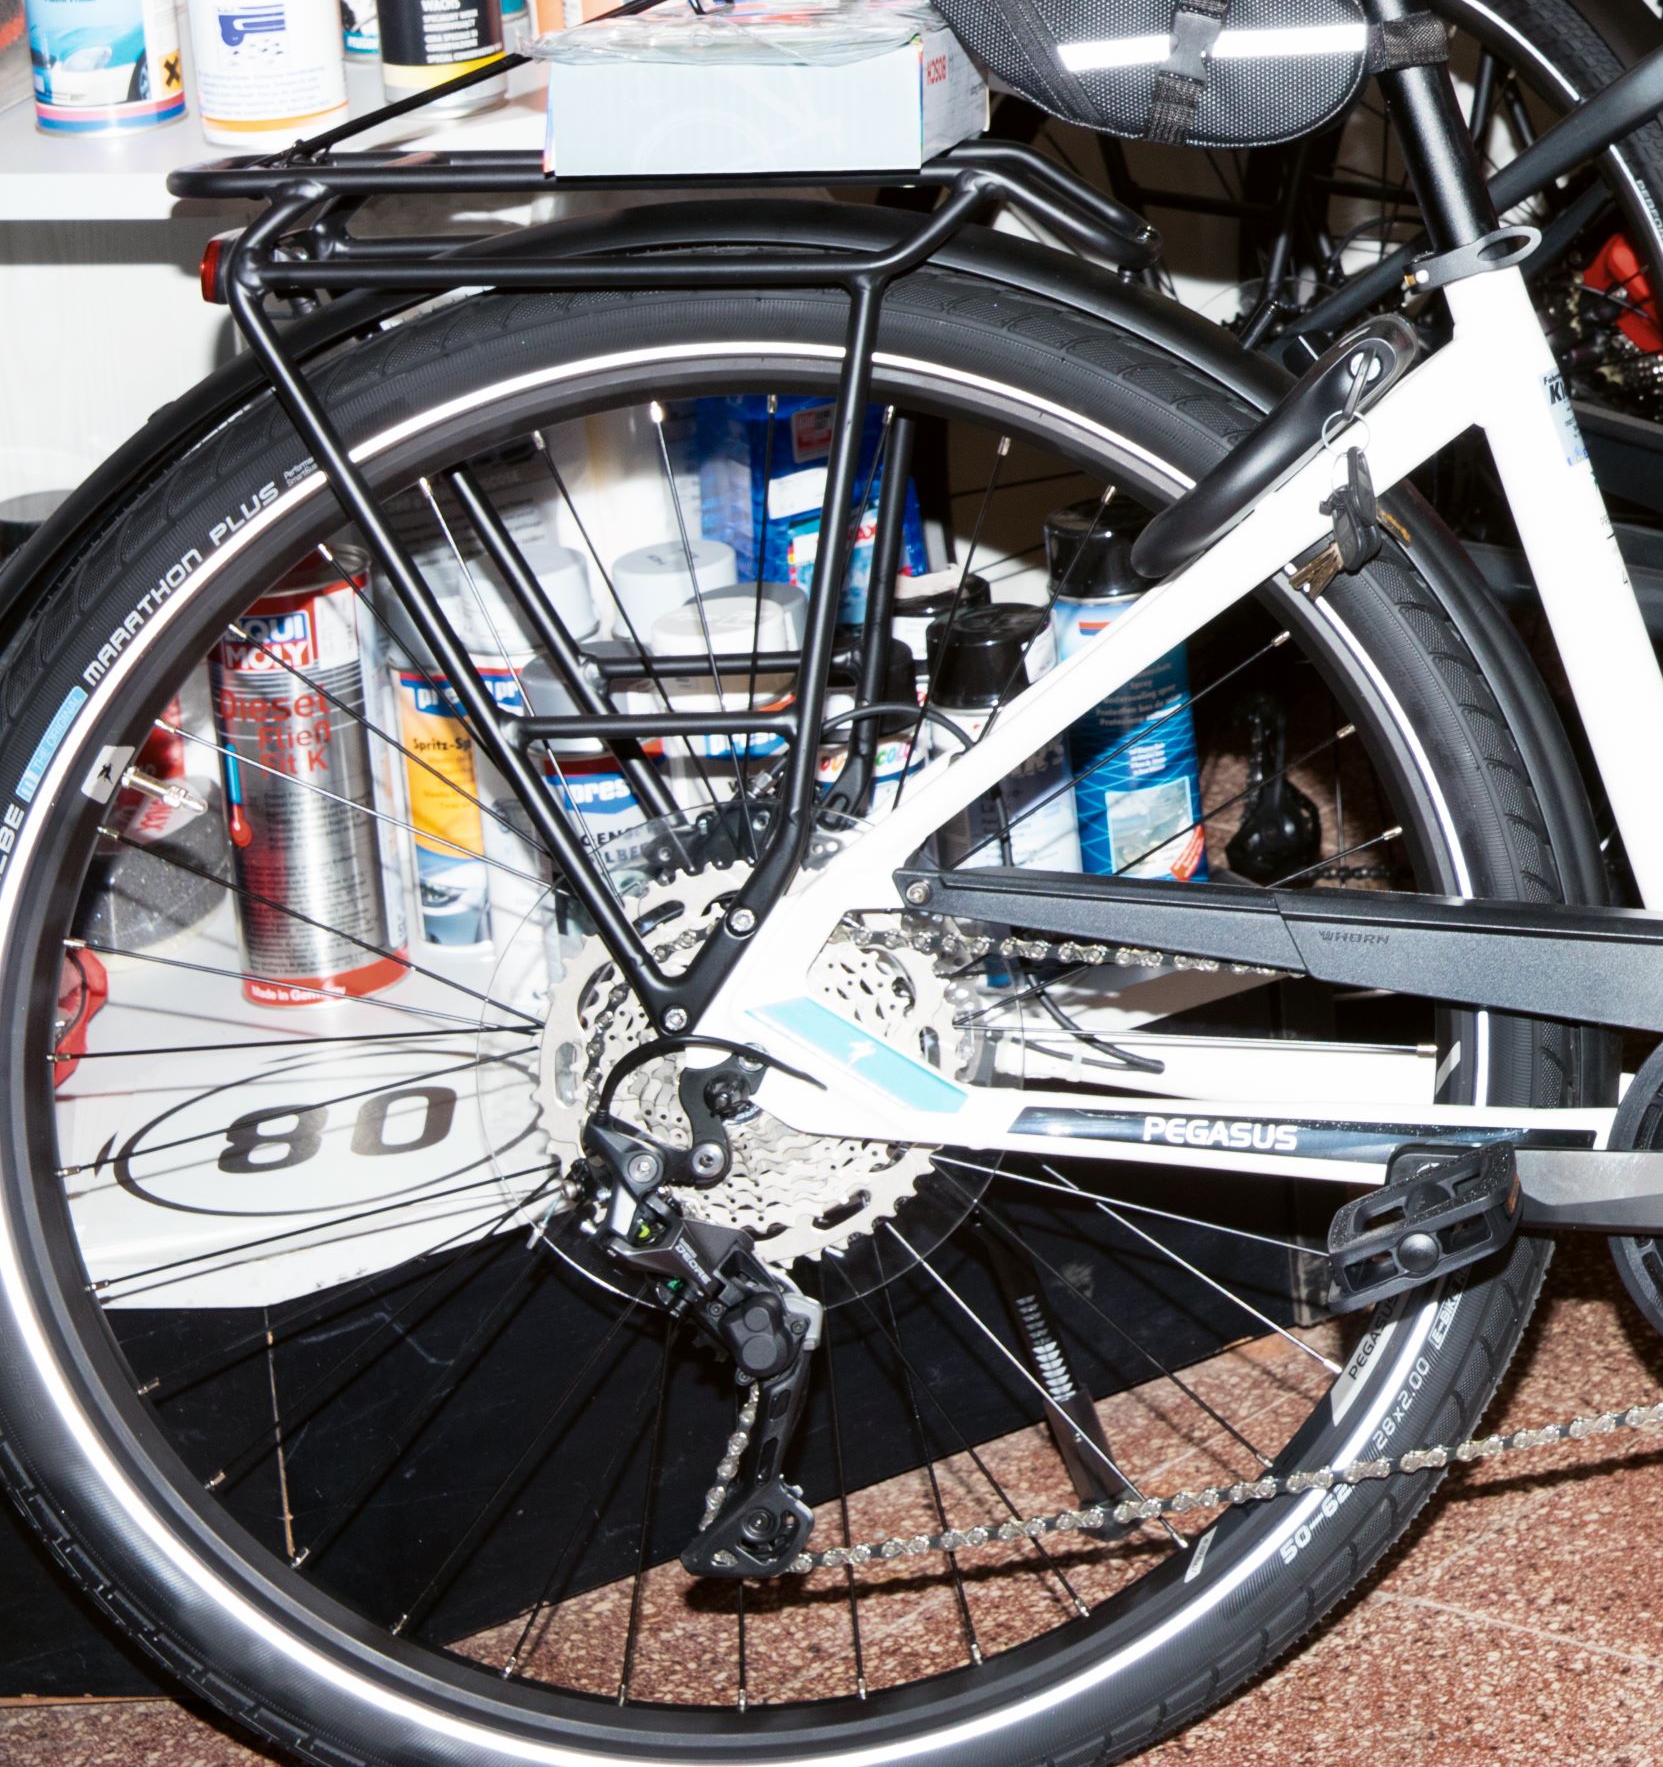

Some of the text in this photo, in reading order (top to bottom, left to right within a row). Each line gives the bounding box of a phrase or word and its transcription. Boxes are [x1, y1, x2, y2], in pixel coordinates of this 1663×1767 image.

[925, 55, 948, 87] BOSCH
[82, 546, 204, 687] MARATHON
[209, 479, 280, 544] PLUS
[225, 641, 309, 670] MOLY
[220, 684, 331, 723] Diesel
[258, 745, 329, 778] Fit K
[412, 736, 472, 752] Spritz-Sp
[1141, 1115, 1299, 1152] PEGASUS
[674, 1244, 712, 1285] DEORE
[1280, 1480, 1355, 1567] 50-62
[1372, 1357, 1430, 1451] 28x2.00
